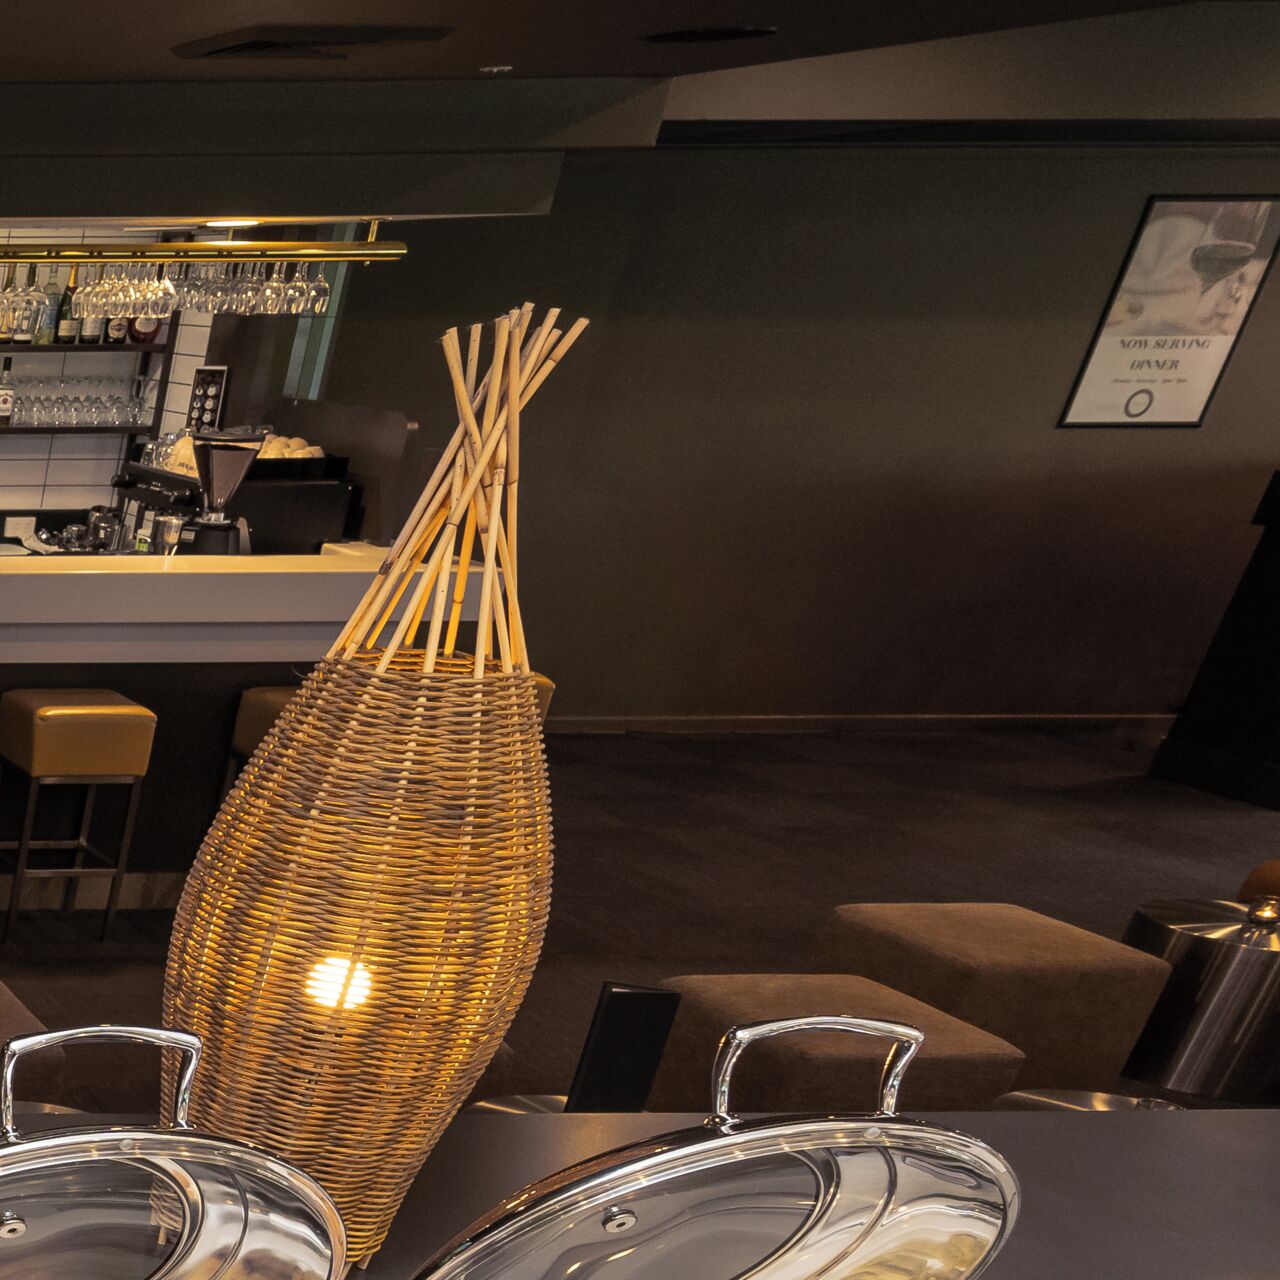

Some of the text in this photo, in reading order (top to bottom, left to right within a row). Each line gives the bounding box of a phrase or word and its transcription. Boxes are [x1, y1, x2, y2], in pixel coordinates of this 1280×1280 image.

[1120, 338, 1211, 349] NOW SERVING
[1129, 359, 1180, 370] DINNER
